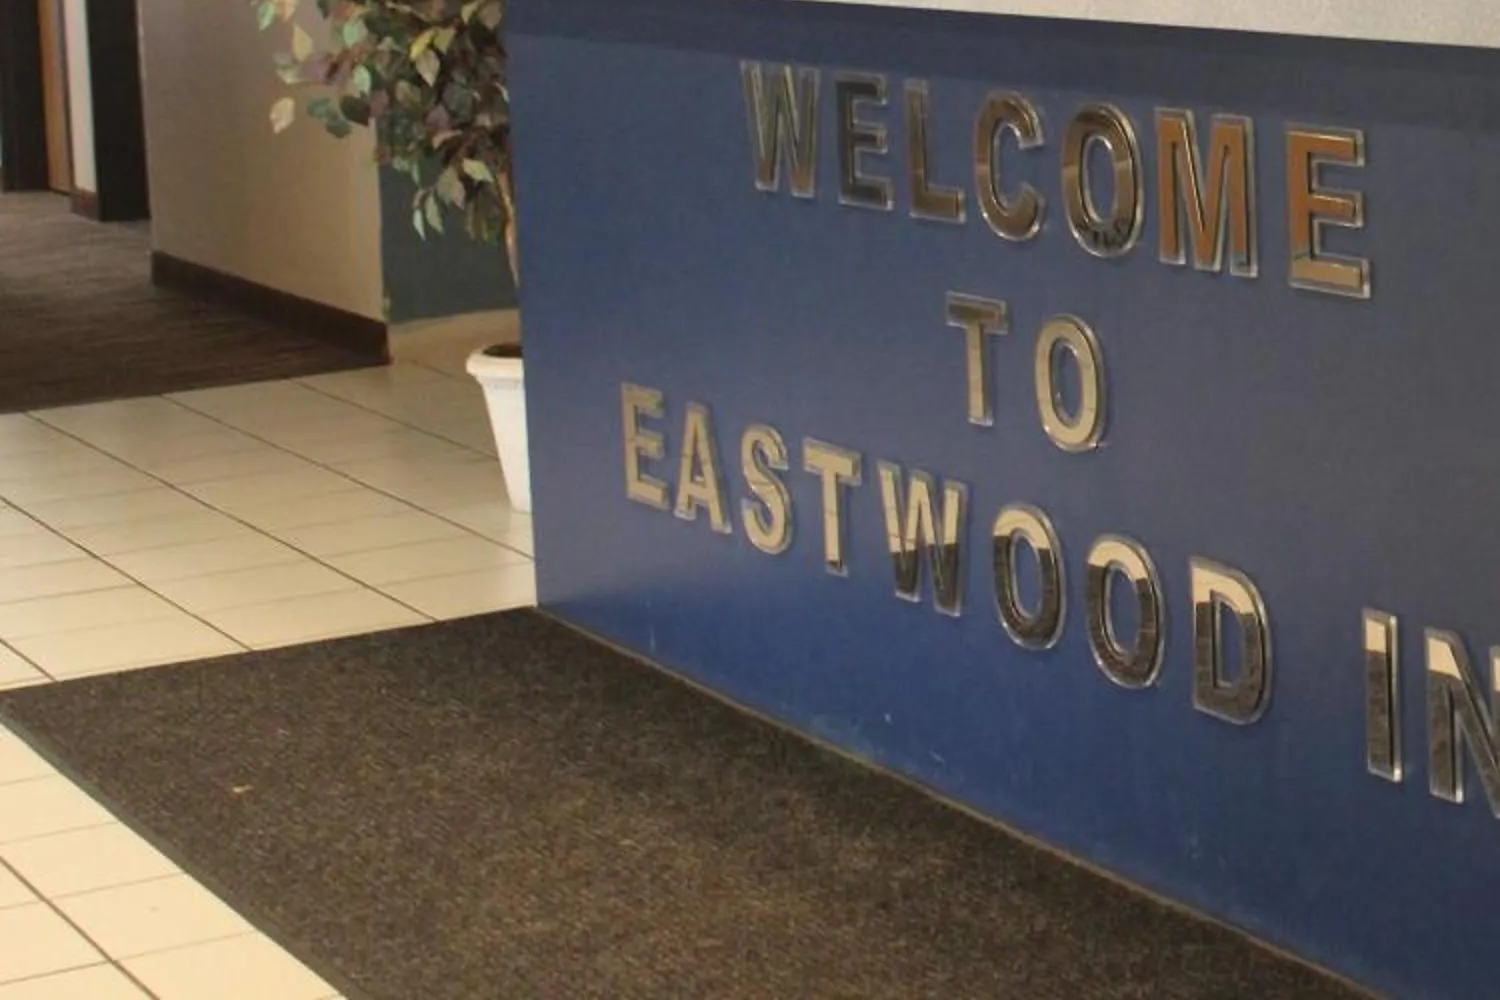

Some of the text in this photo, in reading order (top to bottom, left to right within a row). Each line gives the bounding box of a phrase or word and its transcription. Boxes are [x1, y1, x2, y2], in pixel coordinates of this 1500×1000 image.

[740, 59, 1371, 298] WELCOME
[946, 292, 1107, 452] TO
[620, 381, 1272, 724] EASTWOOD
